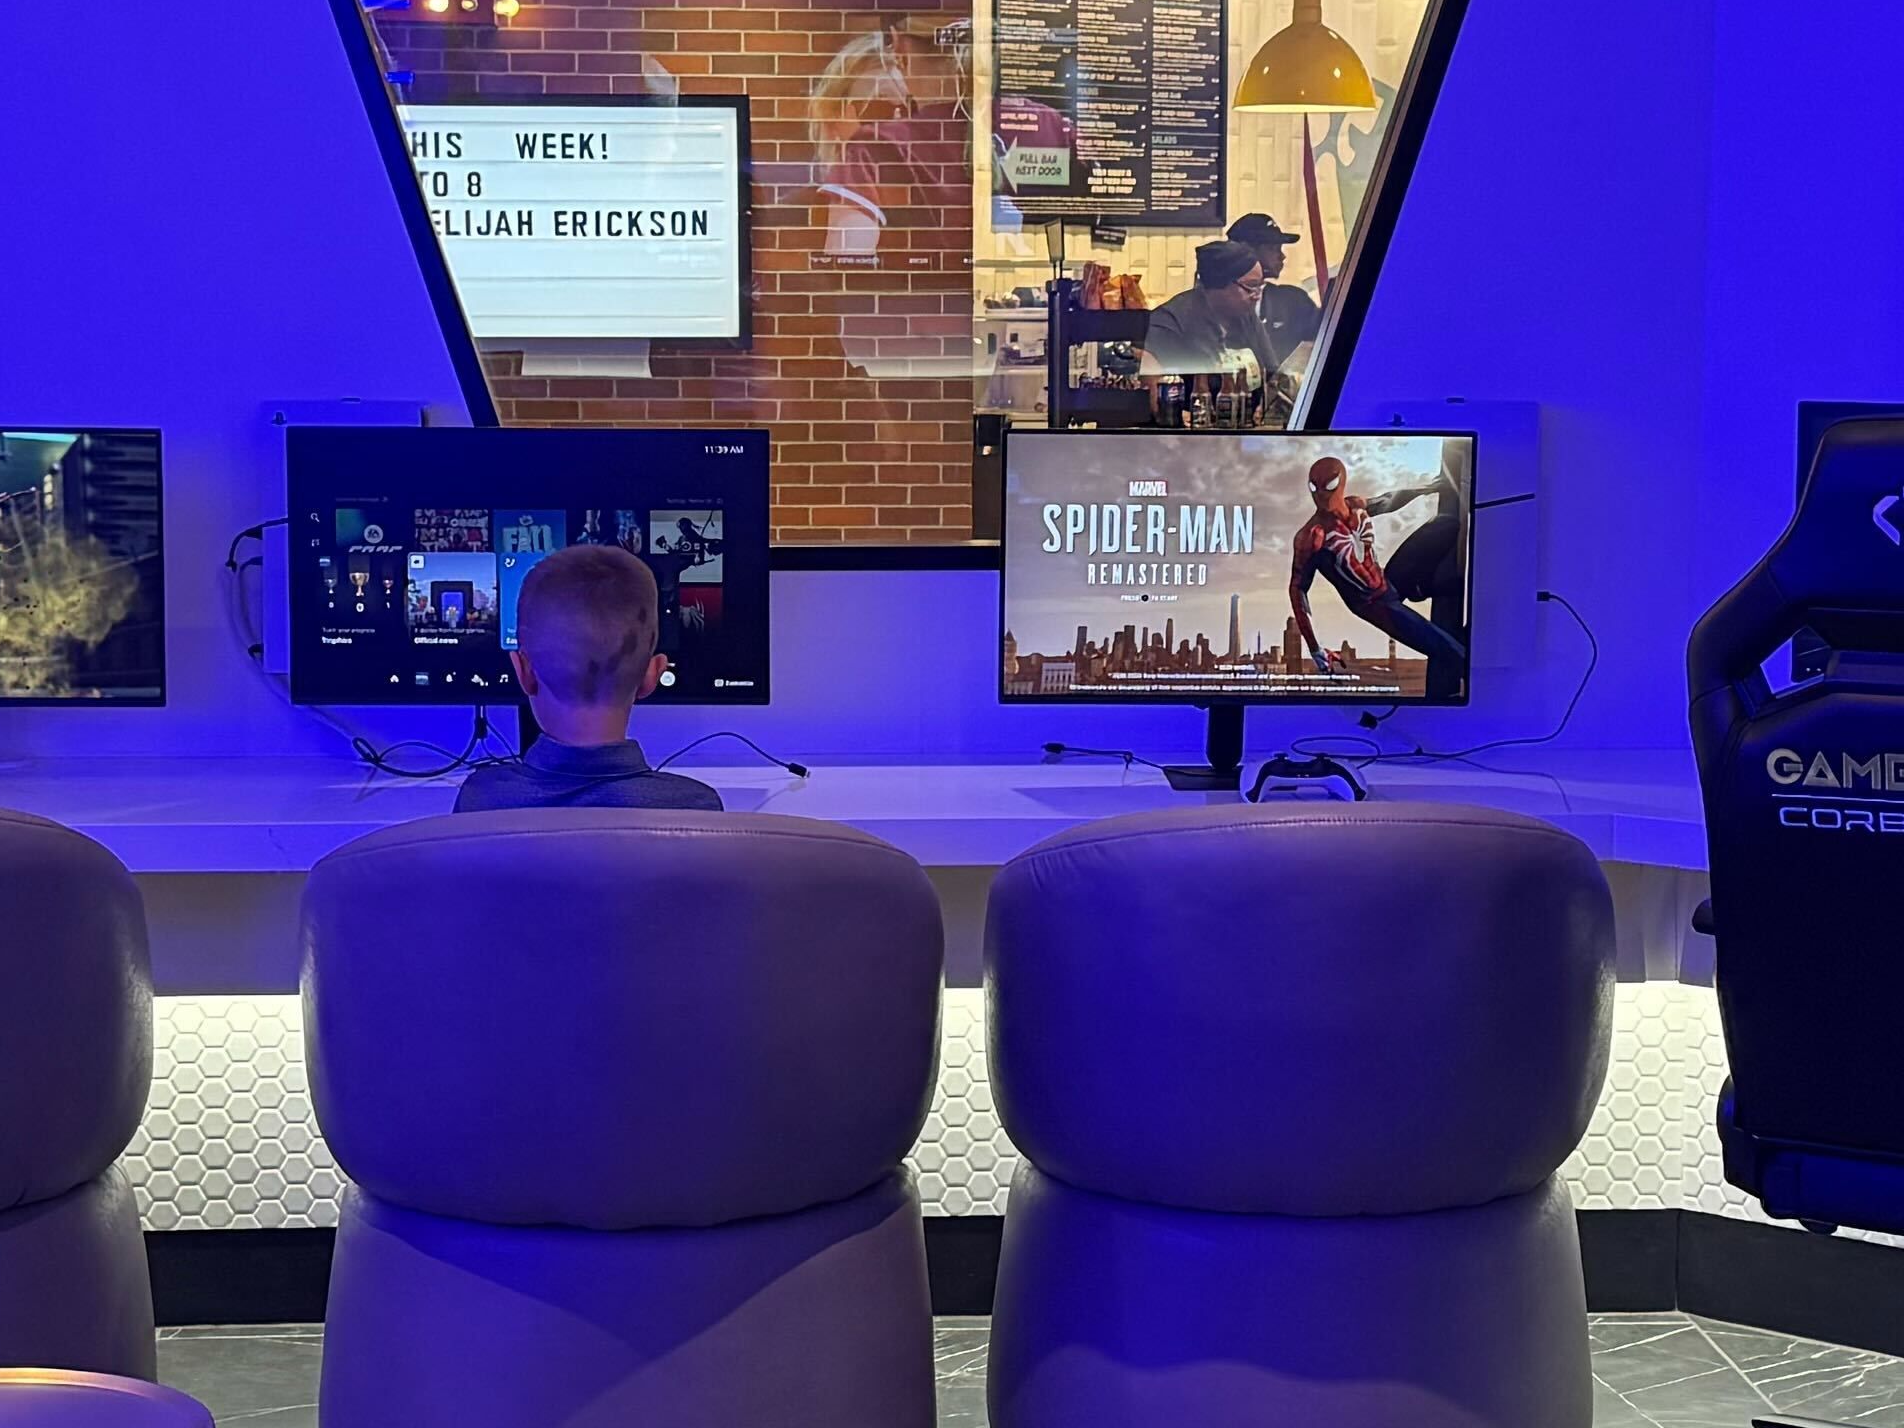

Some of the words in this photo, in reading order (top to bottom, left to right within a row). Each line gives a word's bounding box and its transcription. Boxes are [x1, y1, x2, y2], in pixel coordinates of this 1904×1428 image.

[515, 133, 609, 160] WEEK!
[1038, 167, 1062, 176] DOOR
[467, 171, 482, 197] 8
[554, 210, 707, 236] ERICKSON
[730, 445, 744, 454] AM
[1129, 480, 1168, 497] MARVEL
[1042, 504, 1254, 556] SPIDER-MAN
[1088, 563, 1207, 585] REMASTERED
